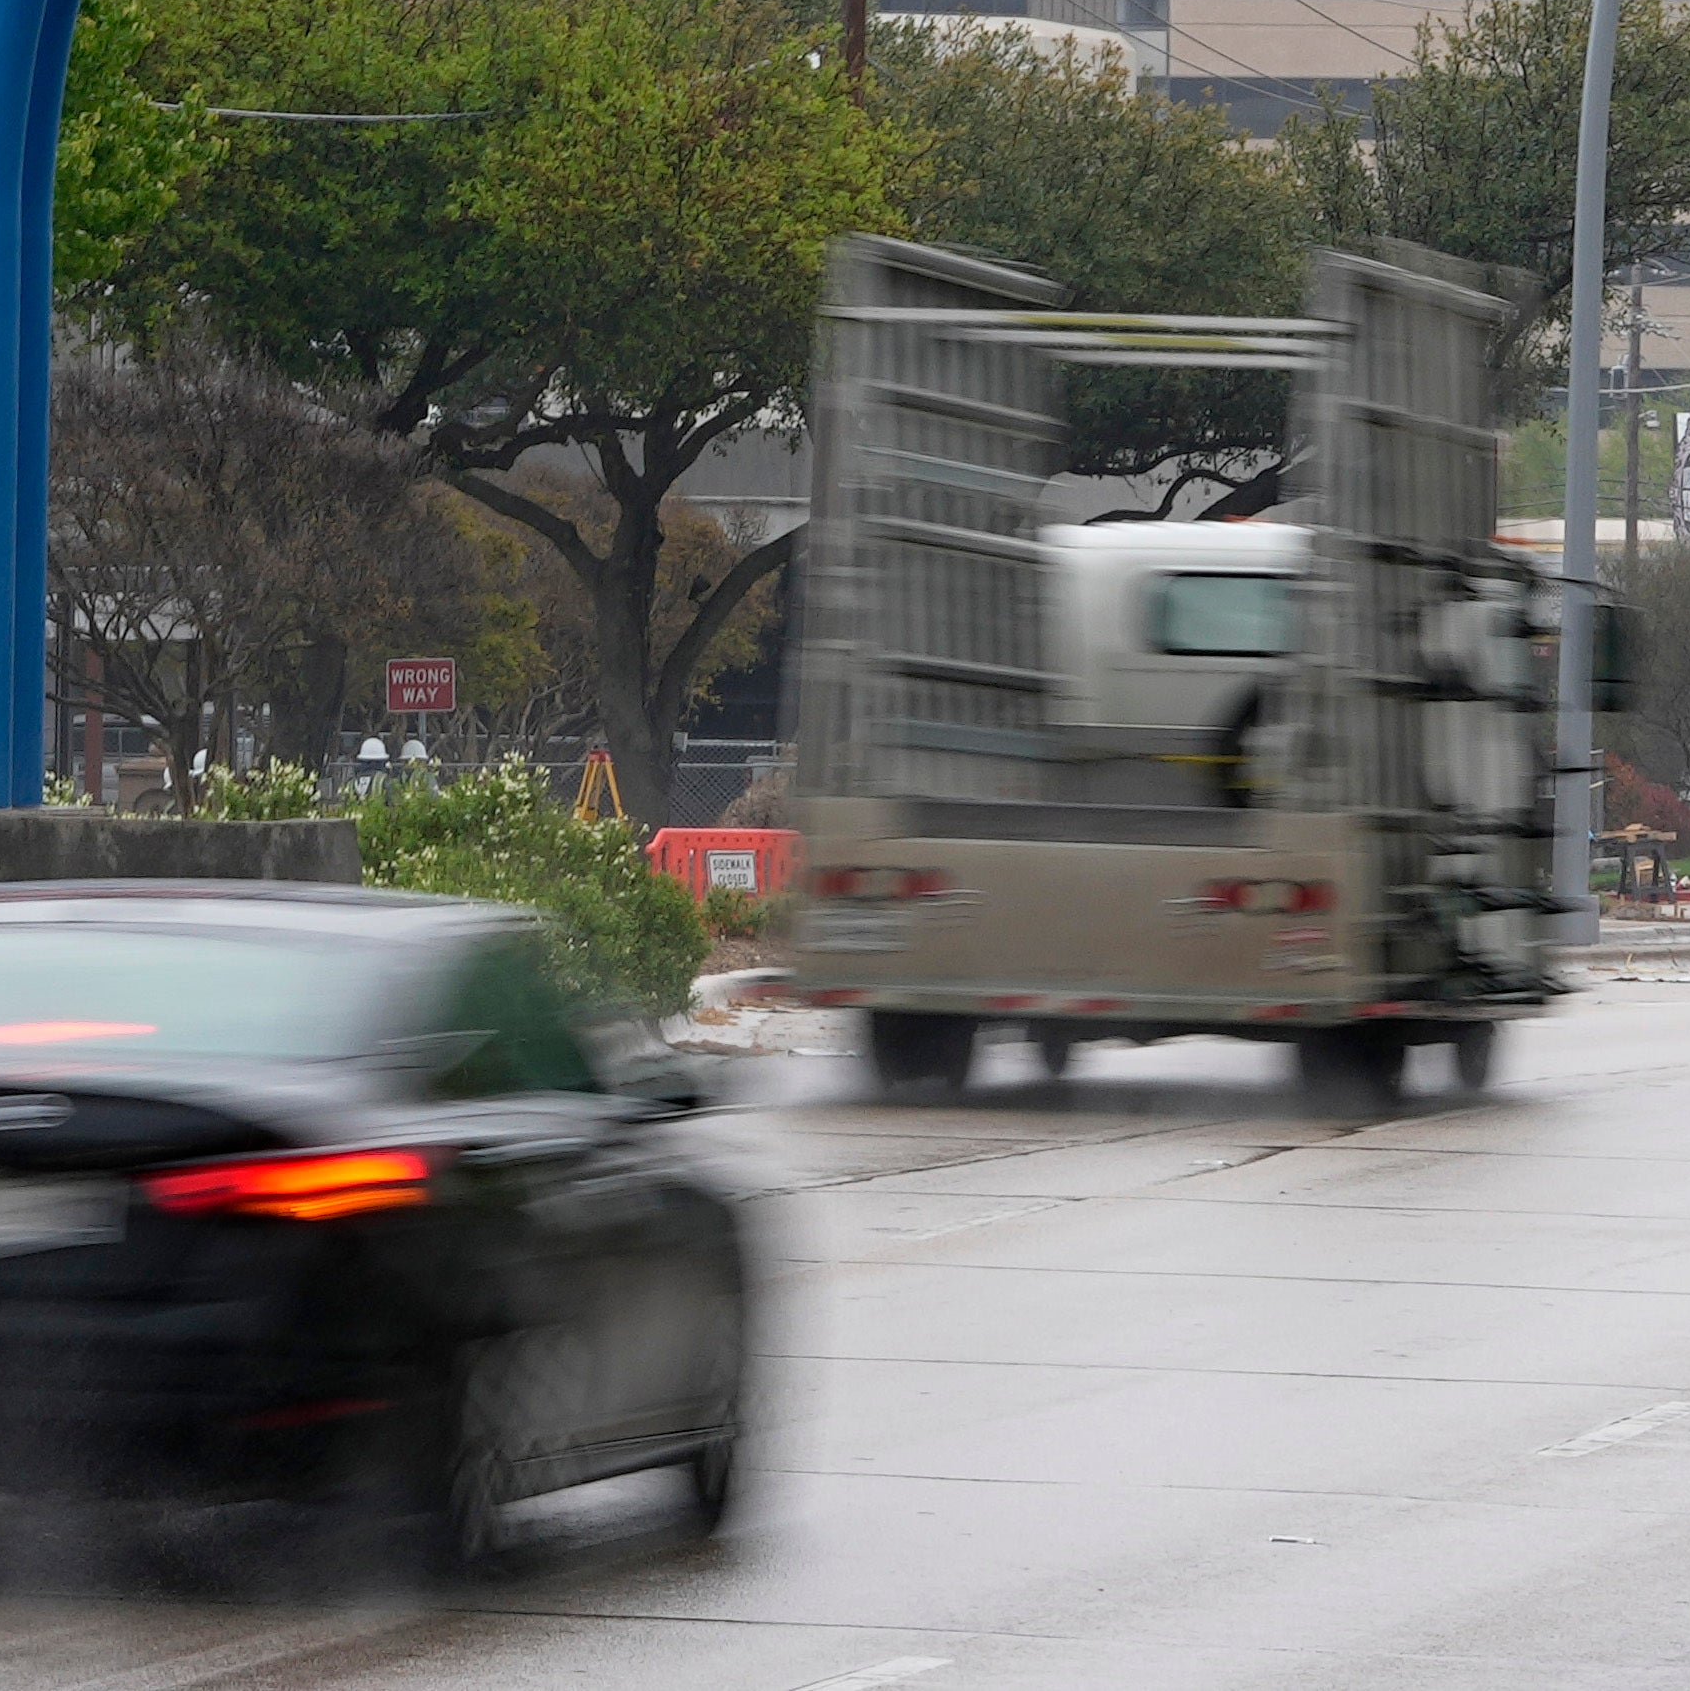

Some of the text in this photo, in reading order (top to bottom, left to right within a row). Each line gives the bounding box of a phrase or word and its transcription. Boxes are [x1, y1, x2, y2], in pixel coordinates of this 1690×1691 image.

[391, 668, 450, 685] WRONG
[402, 687, 438, 703] WAY
[712, 858, 752, 870] SIDEWALK
[717, 873, 749, 887] CLOSED
